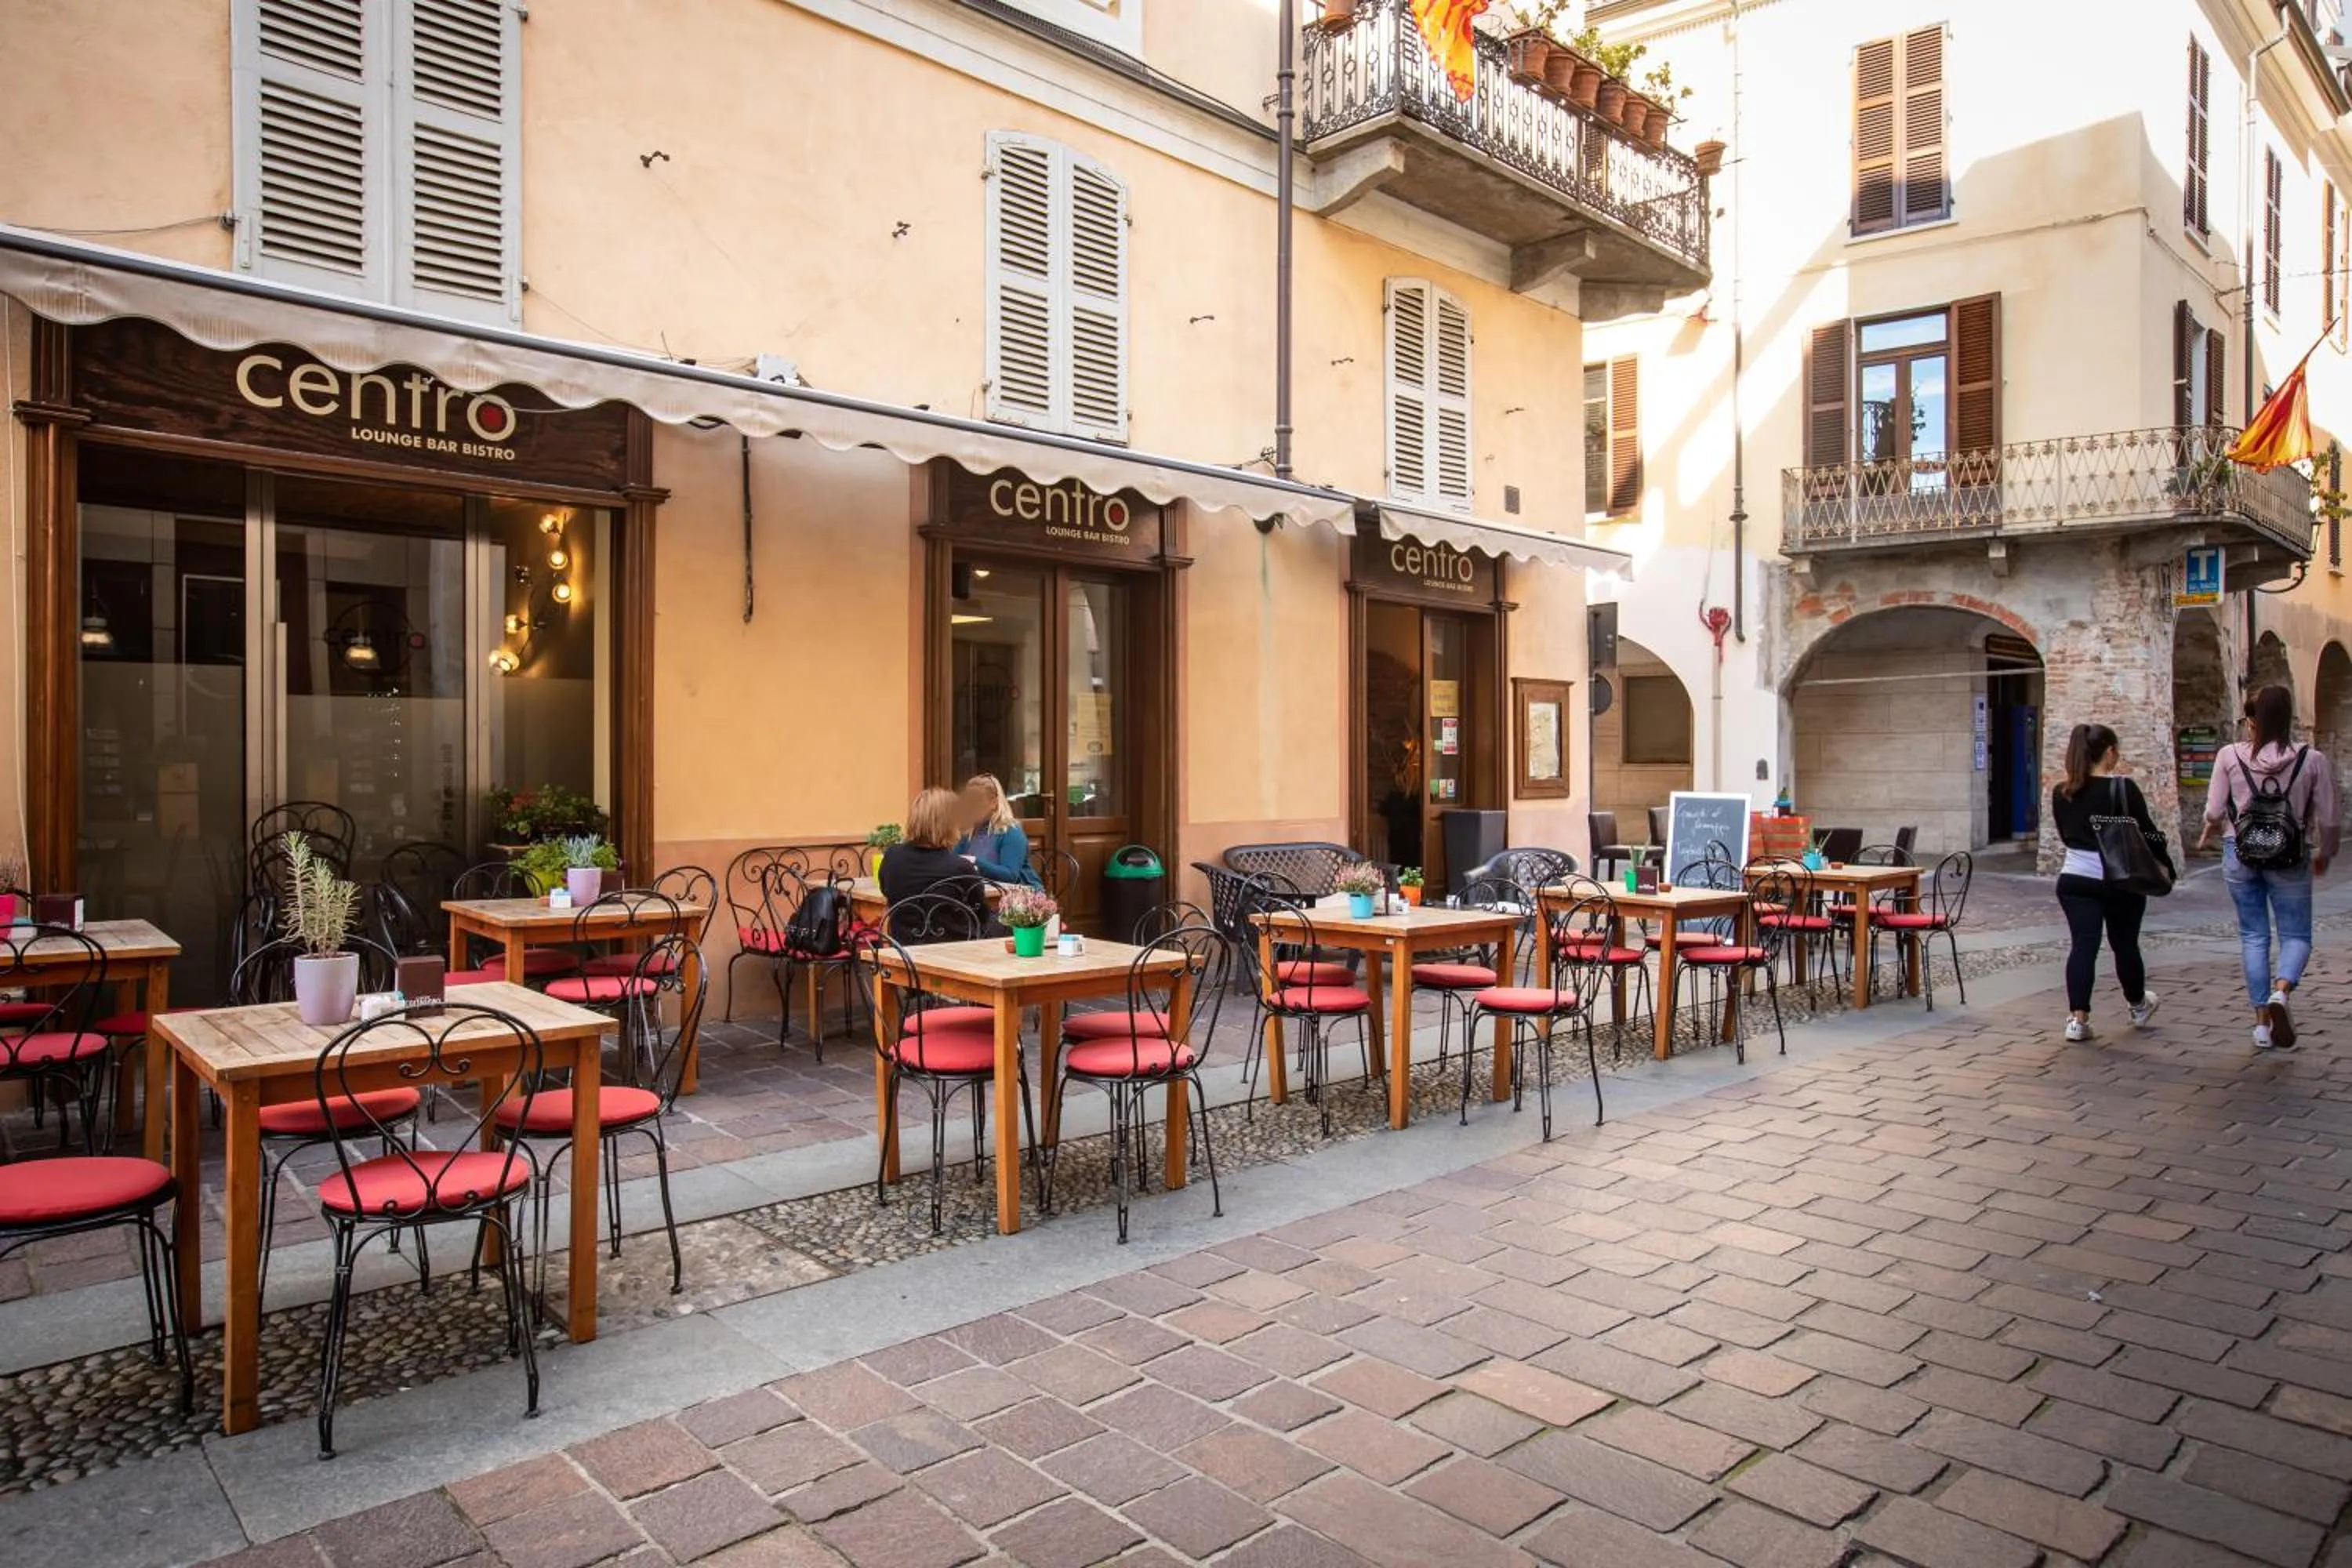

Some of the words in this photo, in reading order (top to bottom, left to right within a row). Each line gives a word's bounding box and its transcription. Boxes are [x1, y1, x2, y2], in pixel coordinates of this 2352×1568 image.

[236, 354, 517, 441] centro
[351, 426, 422, 449] LOUNGE
[426, 437, 458, 454] BAR
[462, 442, 515, 461] BISTRO
[990, 479, 1130, 532] centro
[1046, 525, 1083, 539] LOUNGE
[1083, 531, 1100, 541] BAR
[1102, 534, 1130, 546] BISTRO
[1391, 542, 1473, 583] centro
